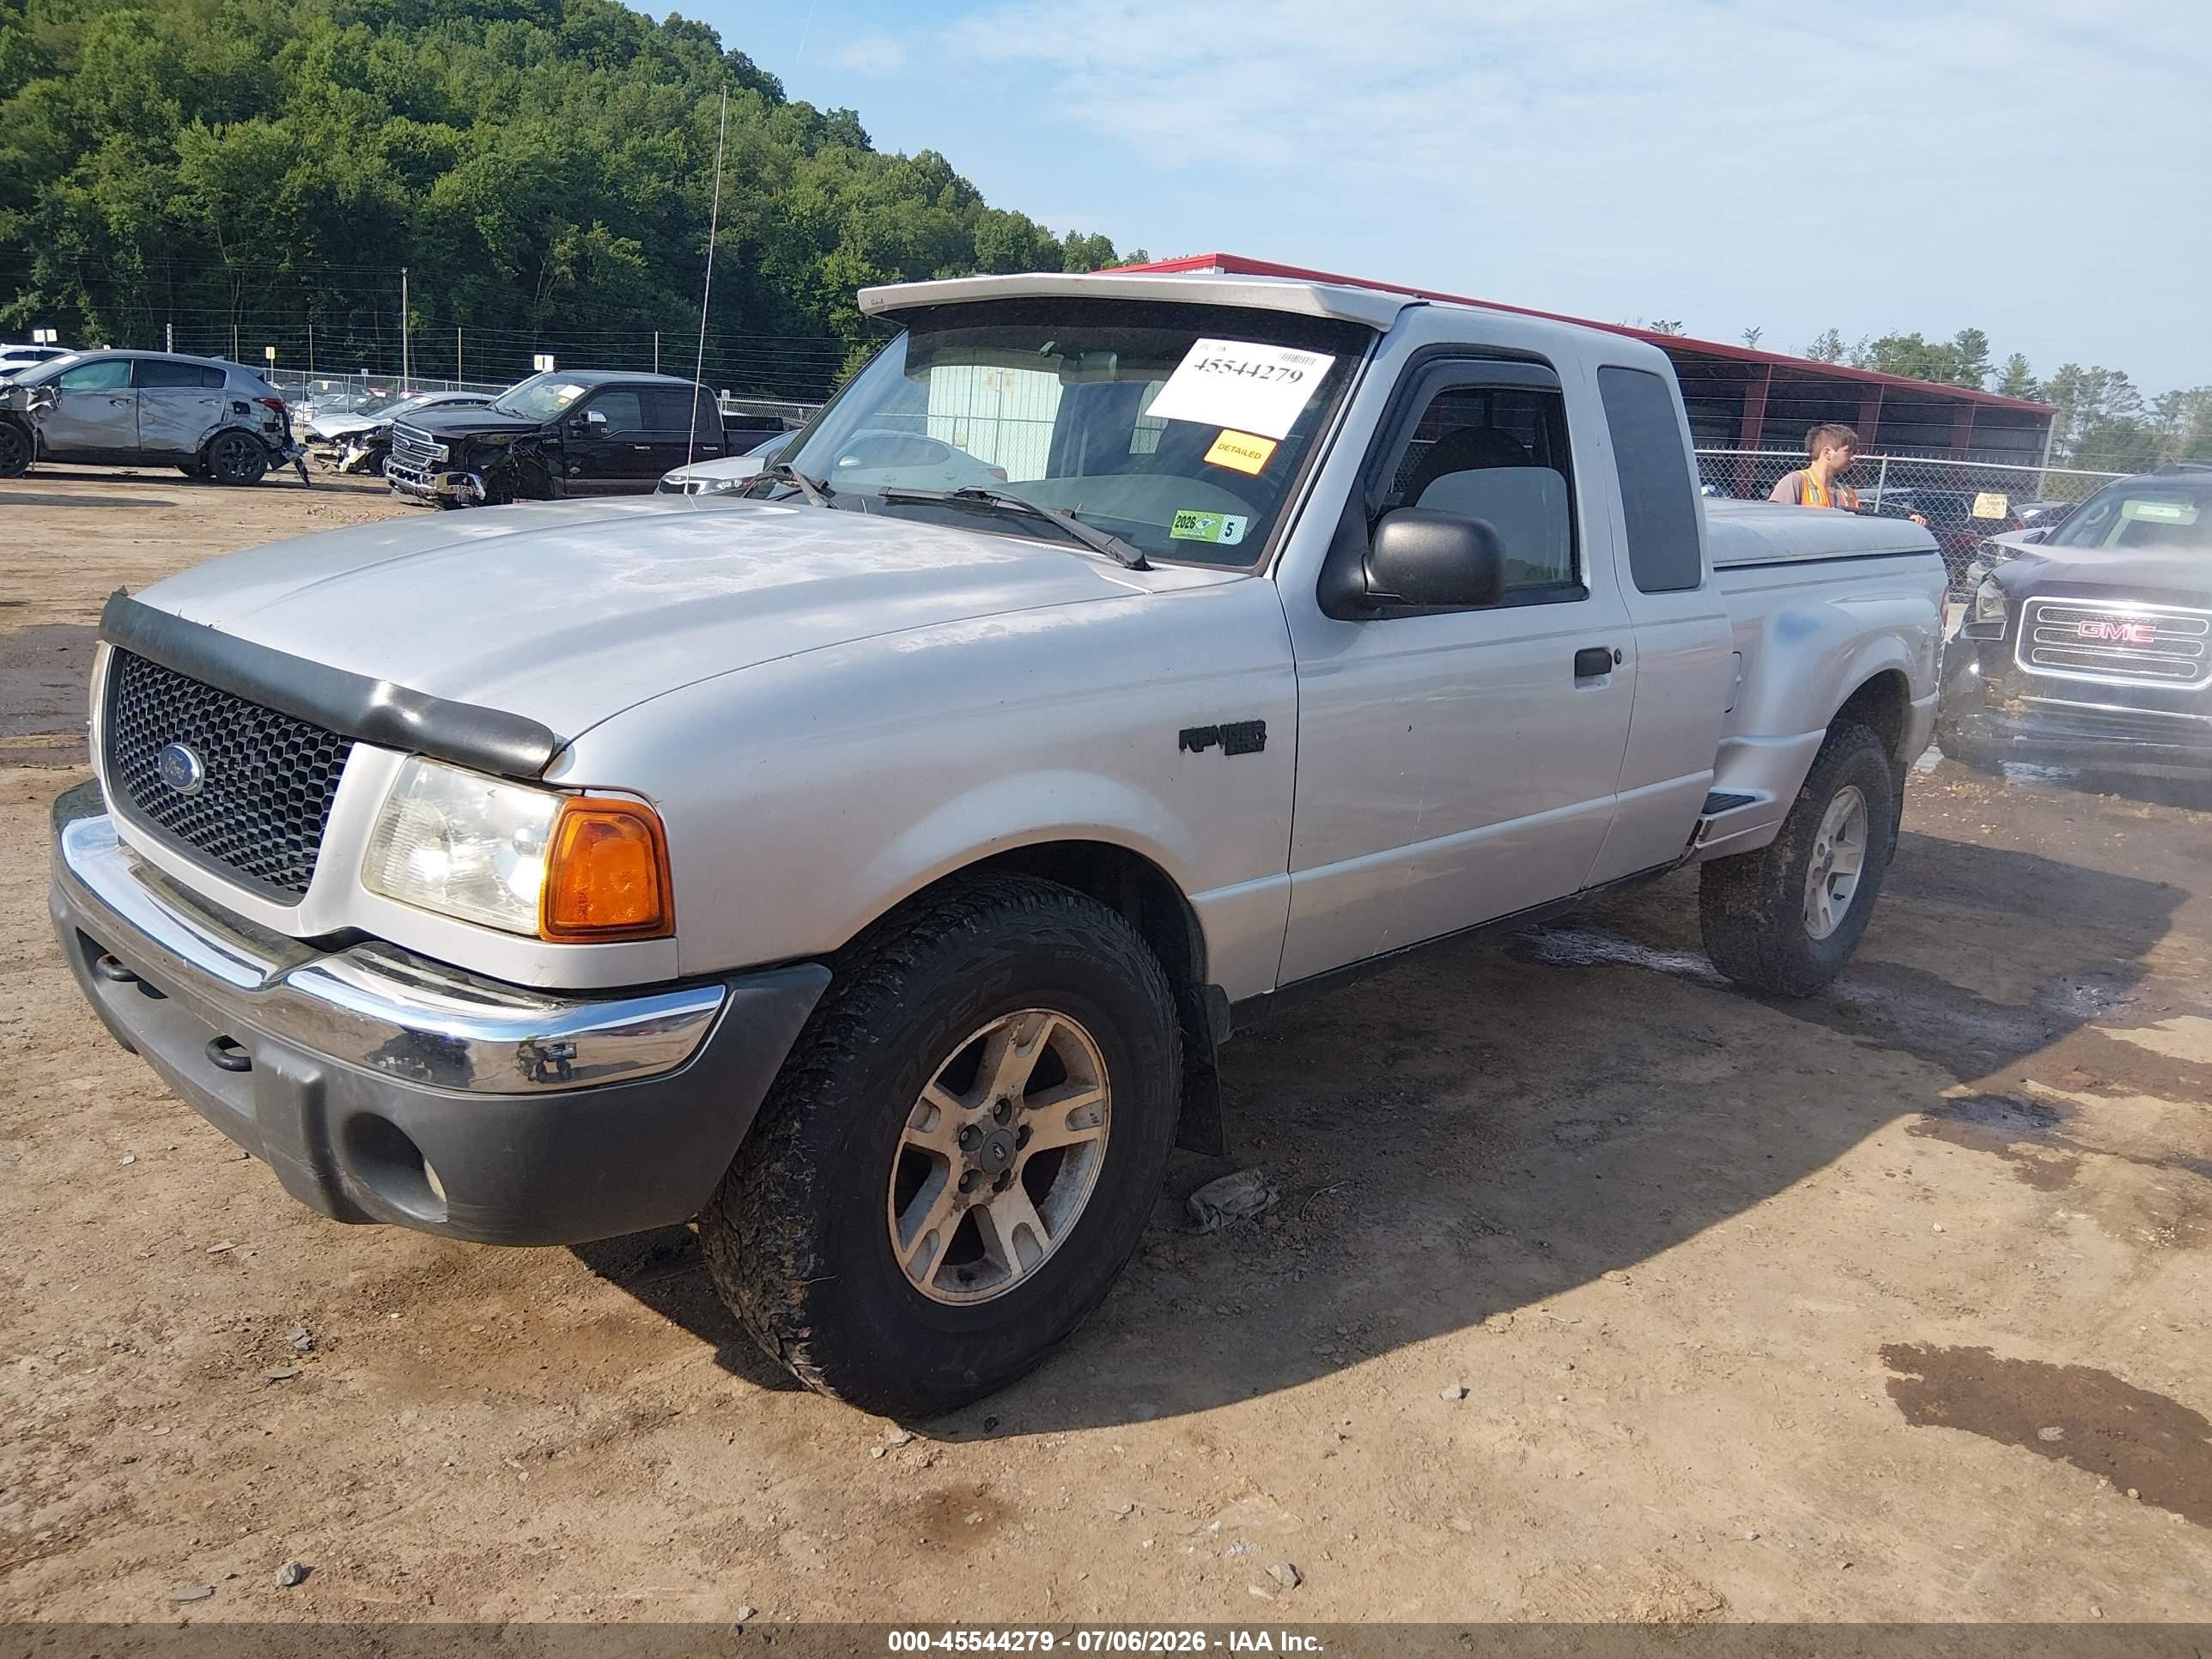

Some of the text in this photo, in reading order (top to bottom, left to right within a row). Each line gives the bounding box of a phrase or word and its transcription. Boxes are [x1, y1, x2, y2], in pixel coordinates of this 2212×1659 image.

[1194, 357, 1304, 384] 45544279
[1218, 443, 1262, 459] DETAILED
[1174, 515, 1197, 530] 2026
[1224, 522, 1235, 538] 5
[2078, 620, 2157, 643] GMC
